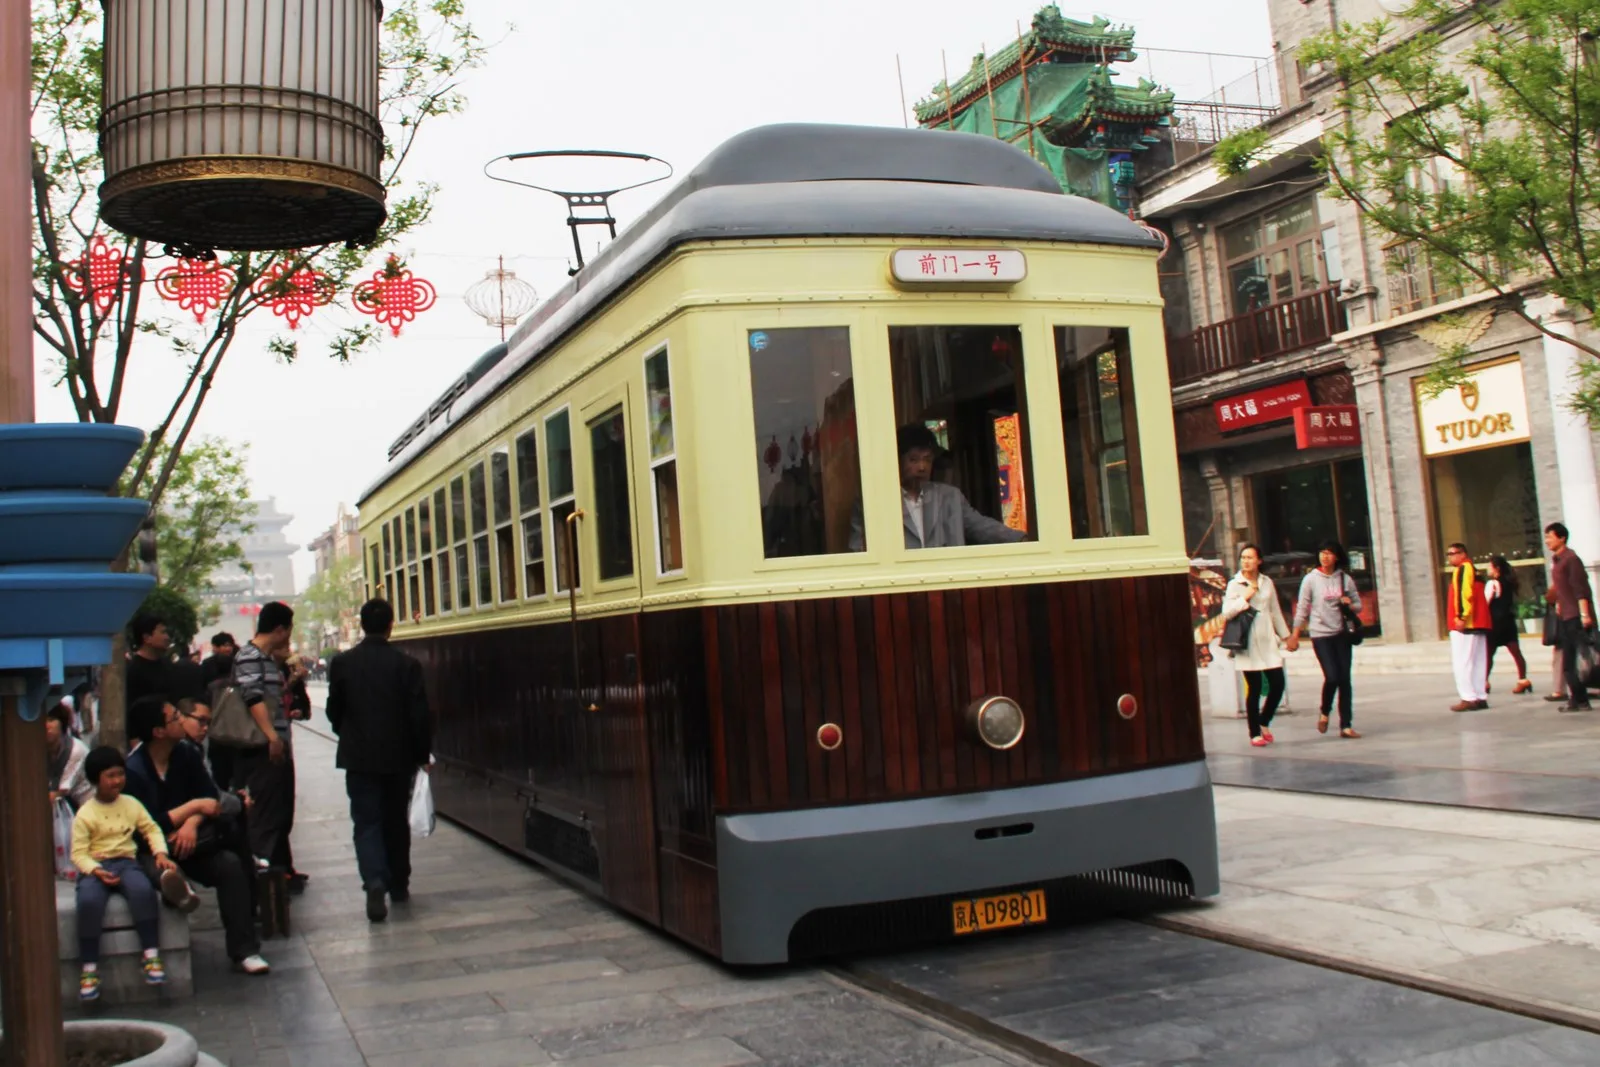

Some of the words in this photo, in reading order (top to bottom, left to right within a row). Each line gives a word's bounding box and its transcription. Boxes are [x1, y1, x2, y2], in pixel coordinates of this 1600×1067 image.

[918, 253, 1002, 276] 前门一号
[1219, 398, 1259, 422] 周大福
[1309, 412, 1353, 428] 周大福
[1435, 412, 1515, 444] TUDOR
